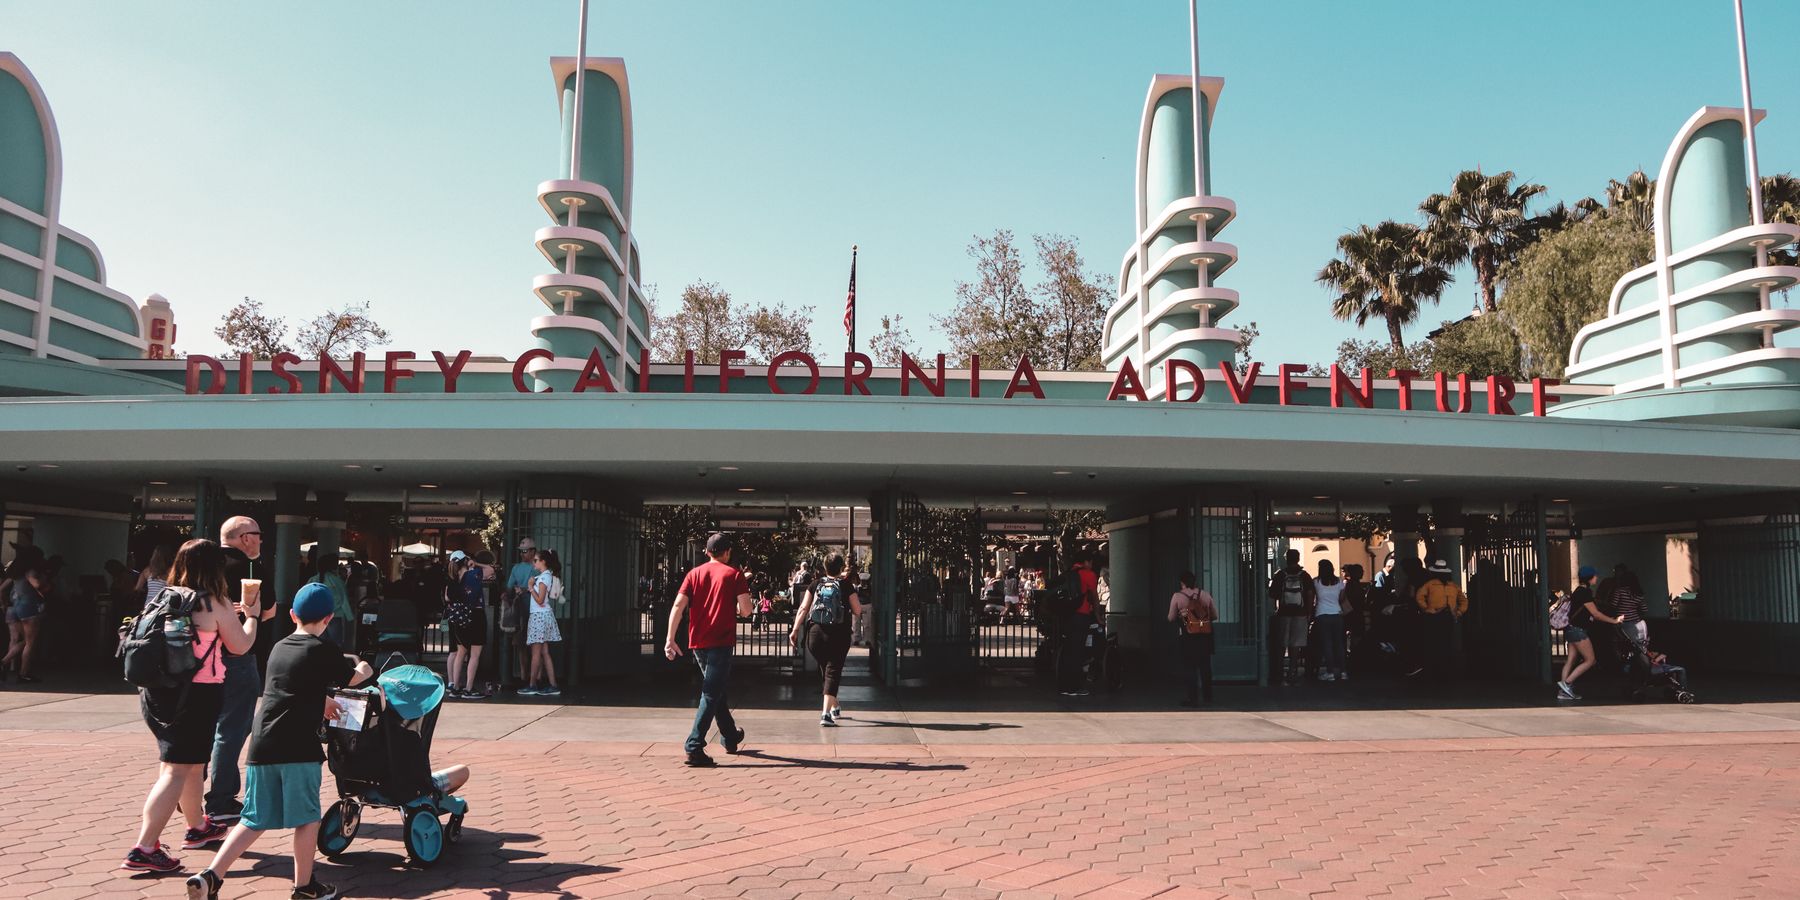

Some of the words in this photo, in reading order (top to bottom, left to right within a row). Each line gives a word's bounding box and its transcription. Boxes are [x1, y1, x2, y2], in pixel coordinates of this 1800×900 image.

[186, 350, 472, 395] DISNEY
[512, 346, 1046, 399] CALIFORNIA
[1106, 355, 1561, 417] ADVENTURE
